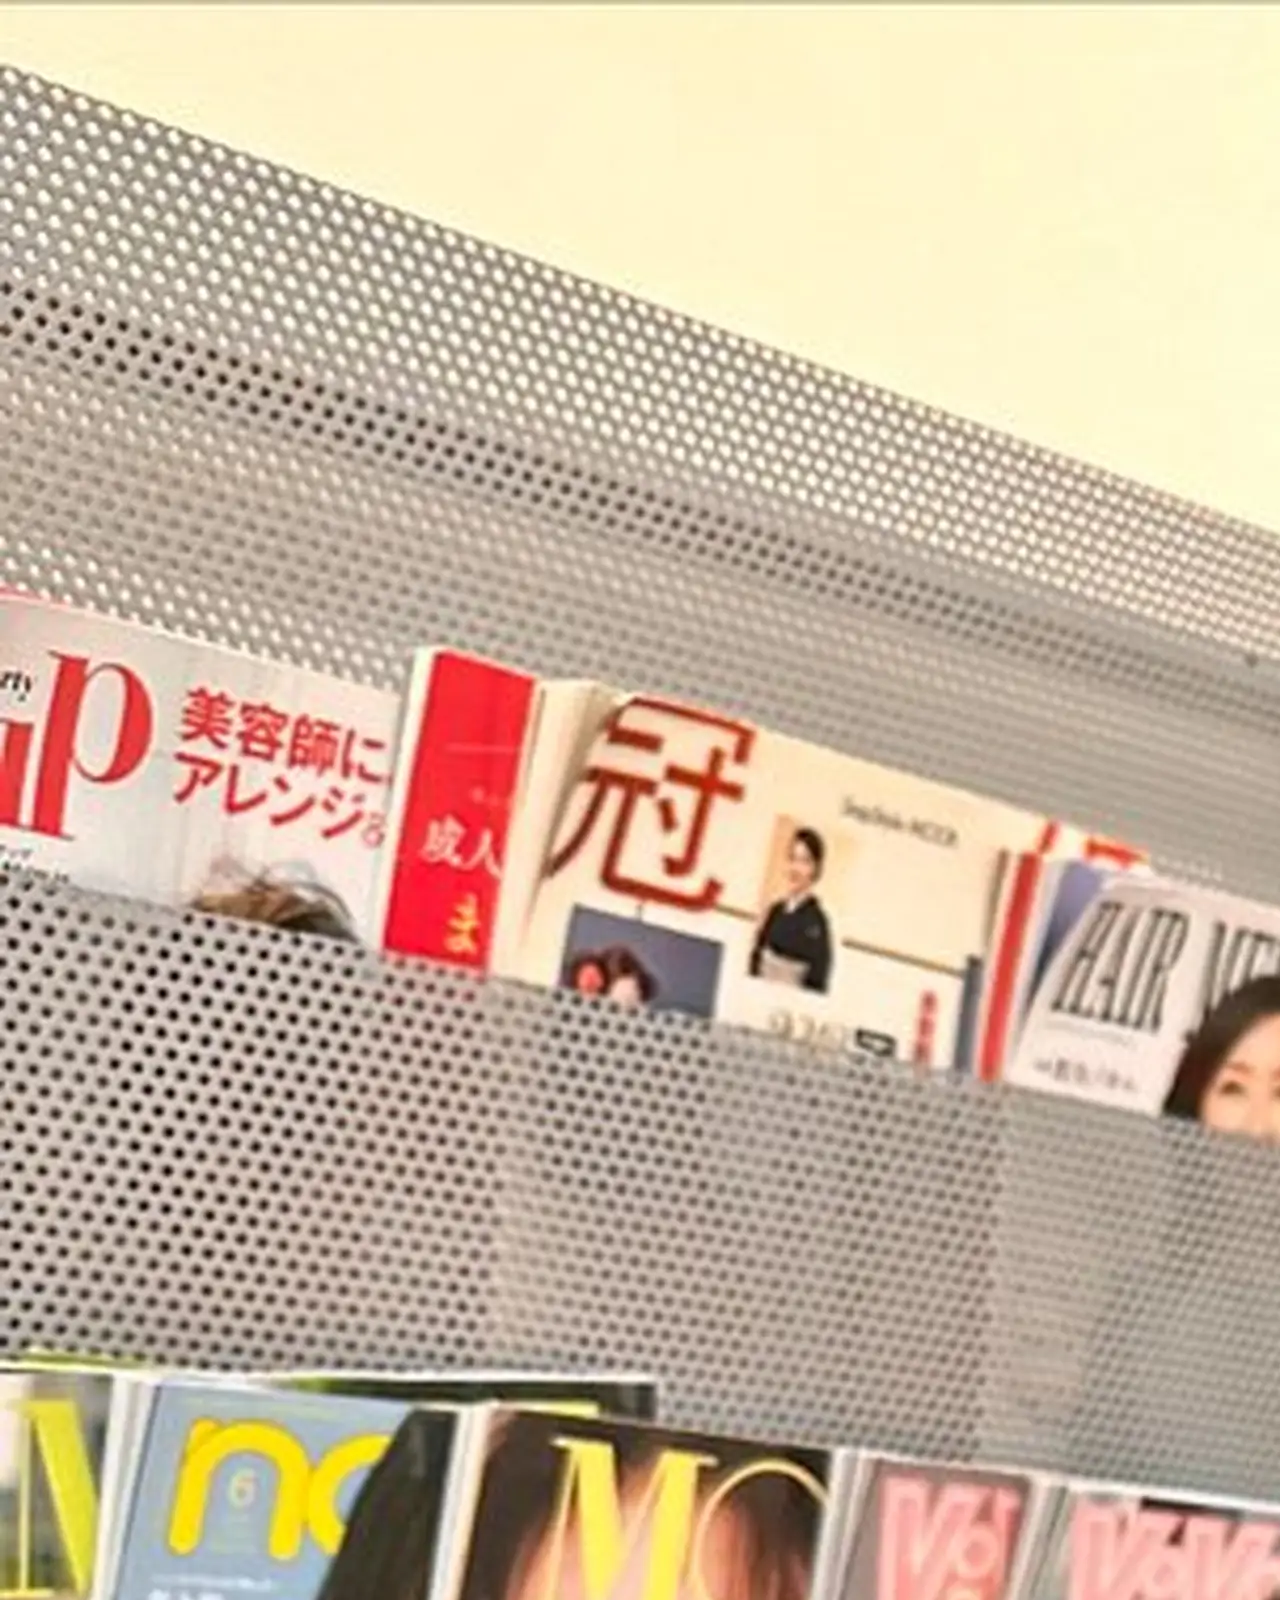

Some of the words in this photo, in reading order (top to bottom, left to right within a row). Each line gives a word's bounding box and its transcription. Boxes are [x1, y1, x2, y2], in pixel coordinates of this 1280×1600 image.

[176, 686, 386, 780] 美容師に
[541, 697, 756, 913] 冠
